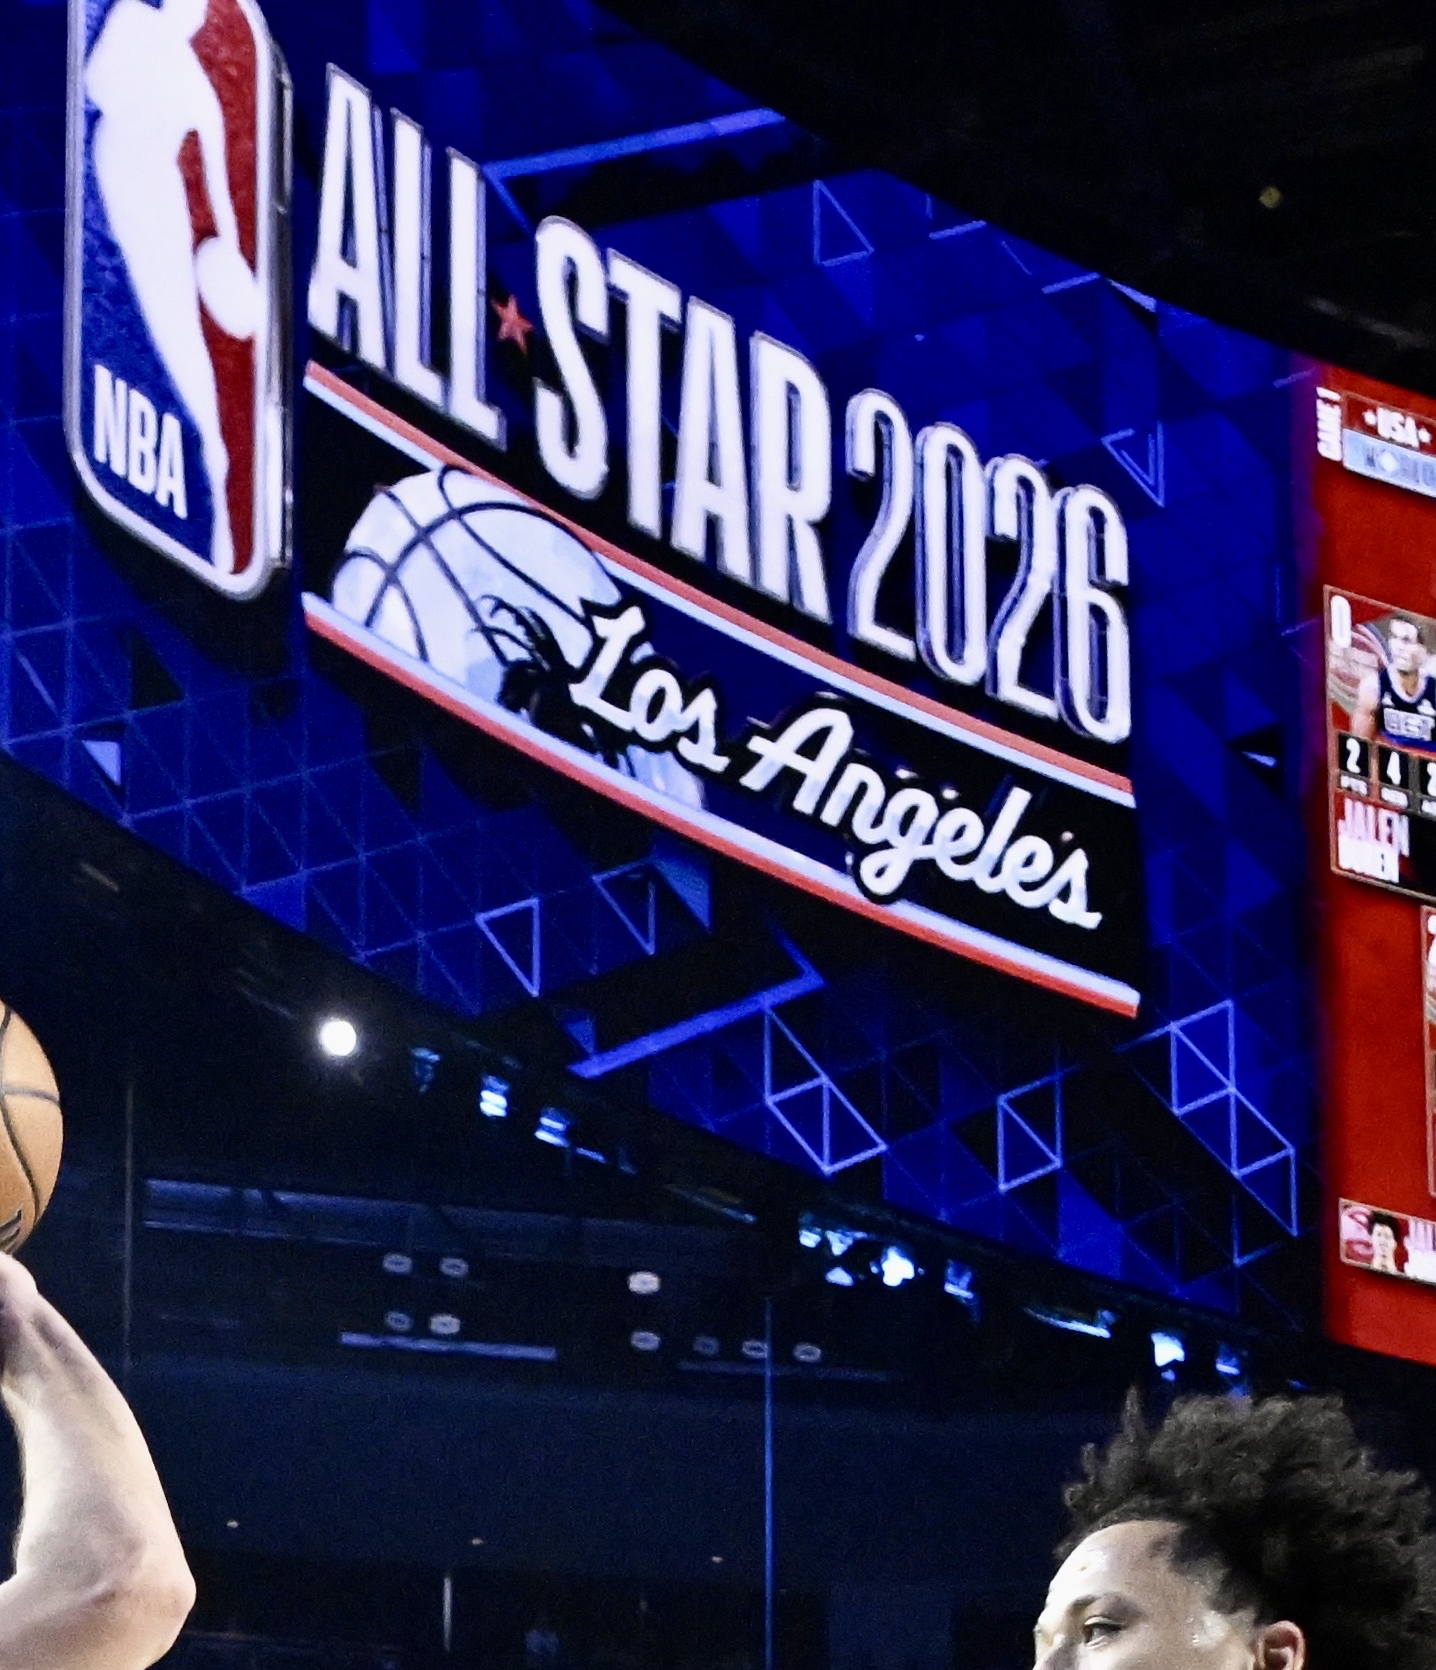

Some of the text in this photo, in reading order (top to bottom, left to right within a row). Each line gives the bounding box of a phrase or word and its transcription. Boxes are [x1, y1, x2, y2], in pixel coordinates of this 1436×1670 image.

[93, 363, 189, 521] NBA
[308, 62, 1133, 745] ALL STAR 2026
[1376, 405, 1421, 449] USA
[568, 604, 1105, 932] Los Angeles
[1345, 736, 1362, 775] 2
[1386, 750, 1402, 787] 4
